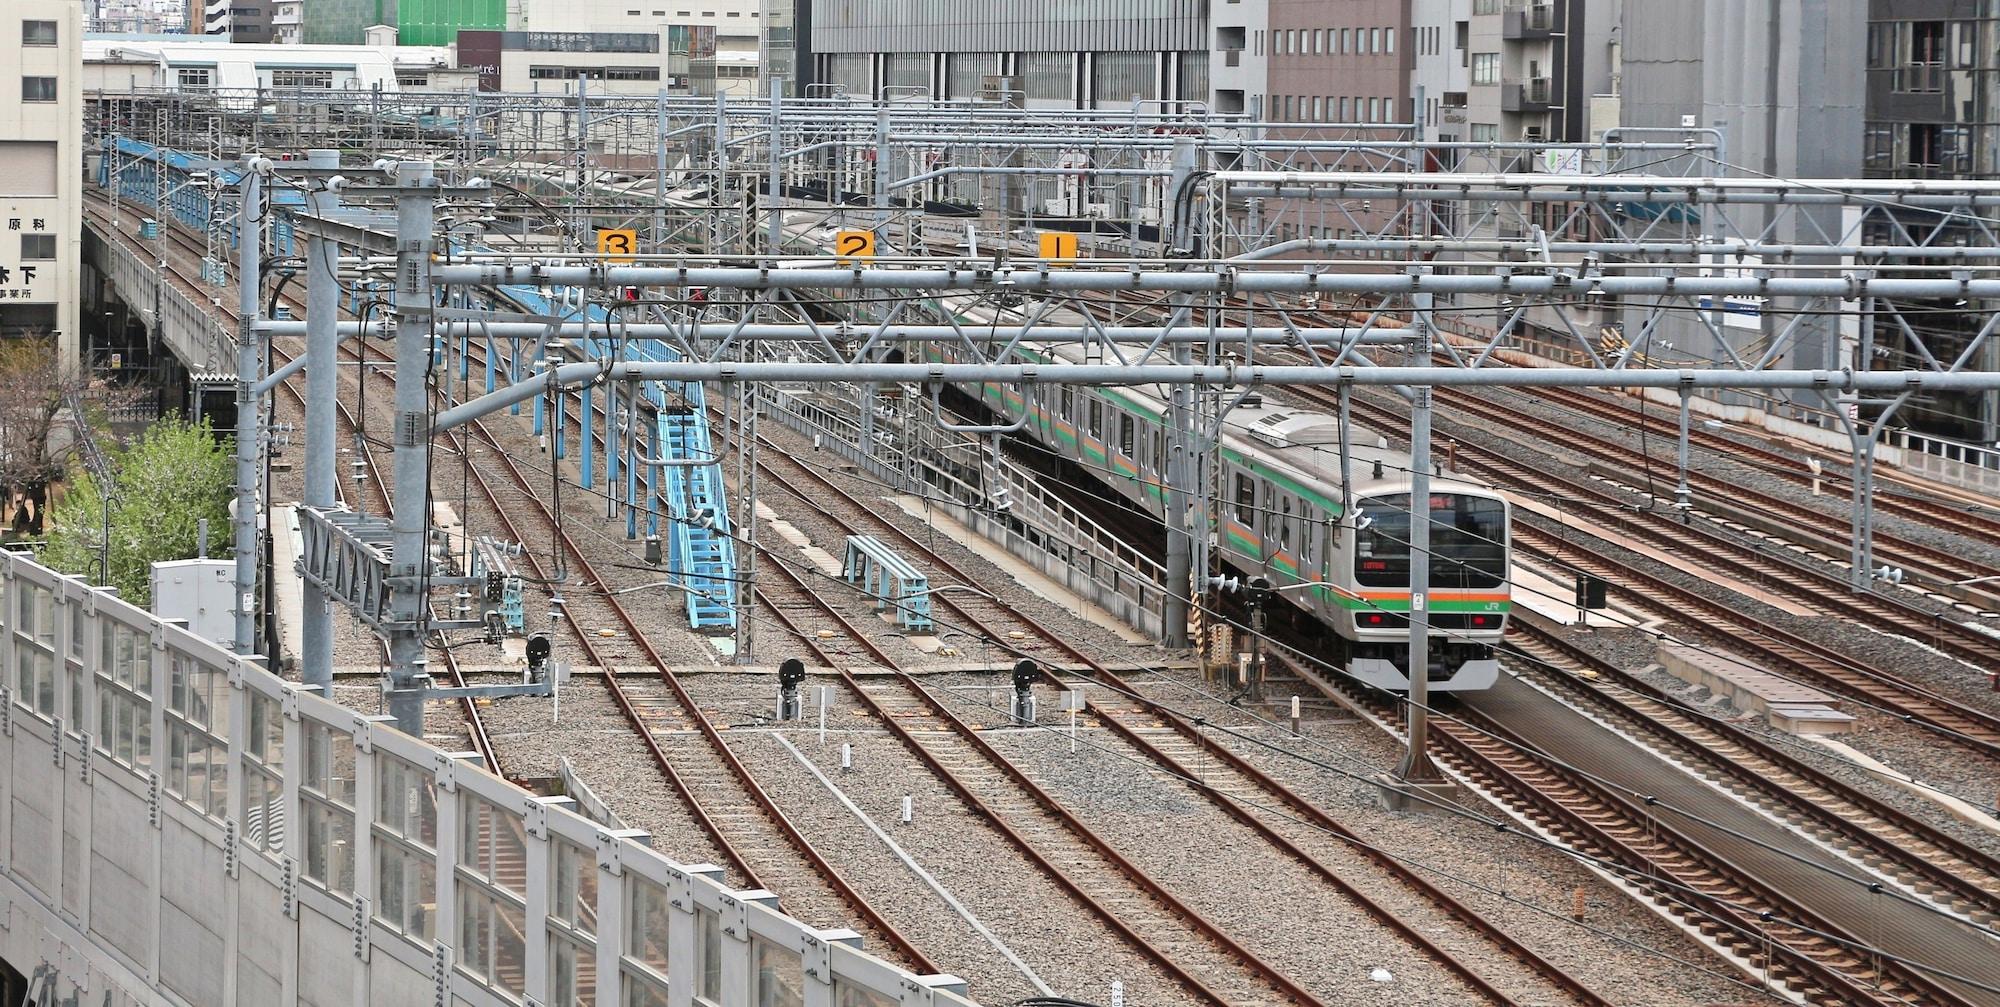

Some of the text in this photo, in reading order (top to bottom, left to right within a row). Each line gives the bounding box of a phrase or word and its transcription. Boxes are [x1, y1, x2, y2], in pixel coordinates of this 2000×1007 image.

[605, 233, 630, 254] 3
[843, 235, 868, 256] 2
[1484, 602, 1500, 611] JR
